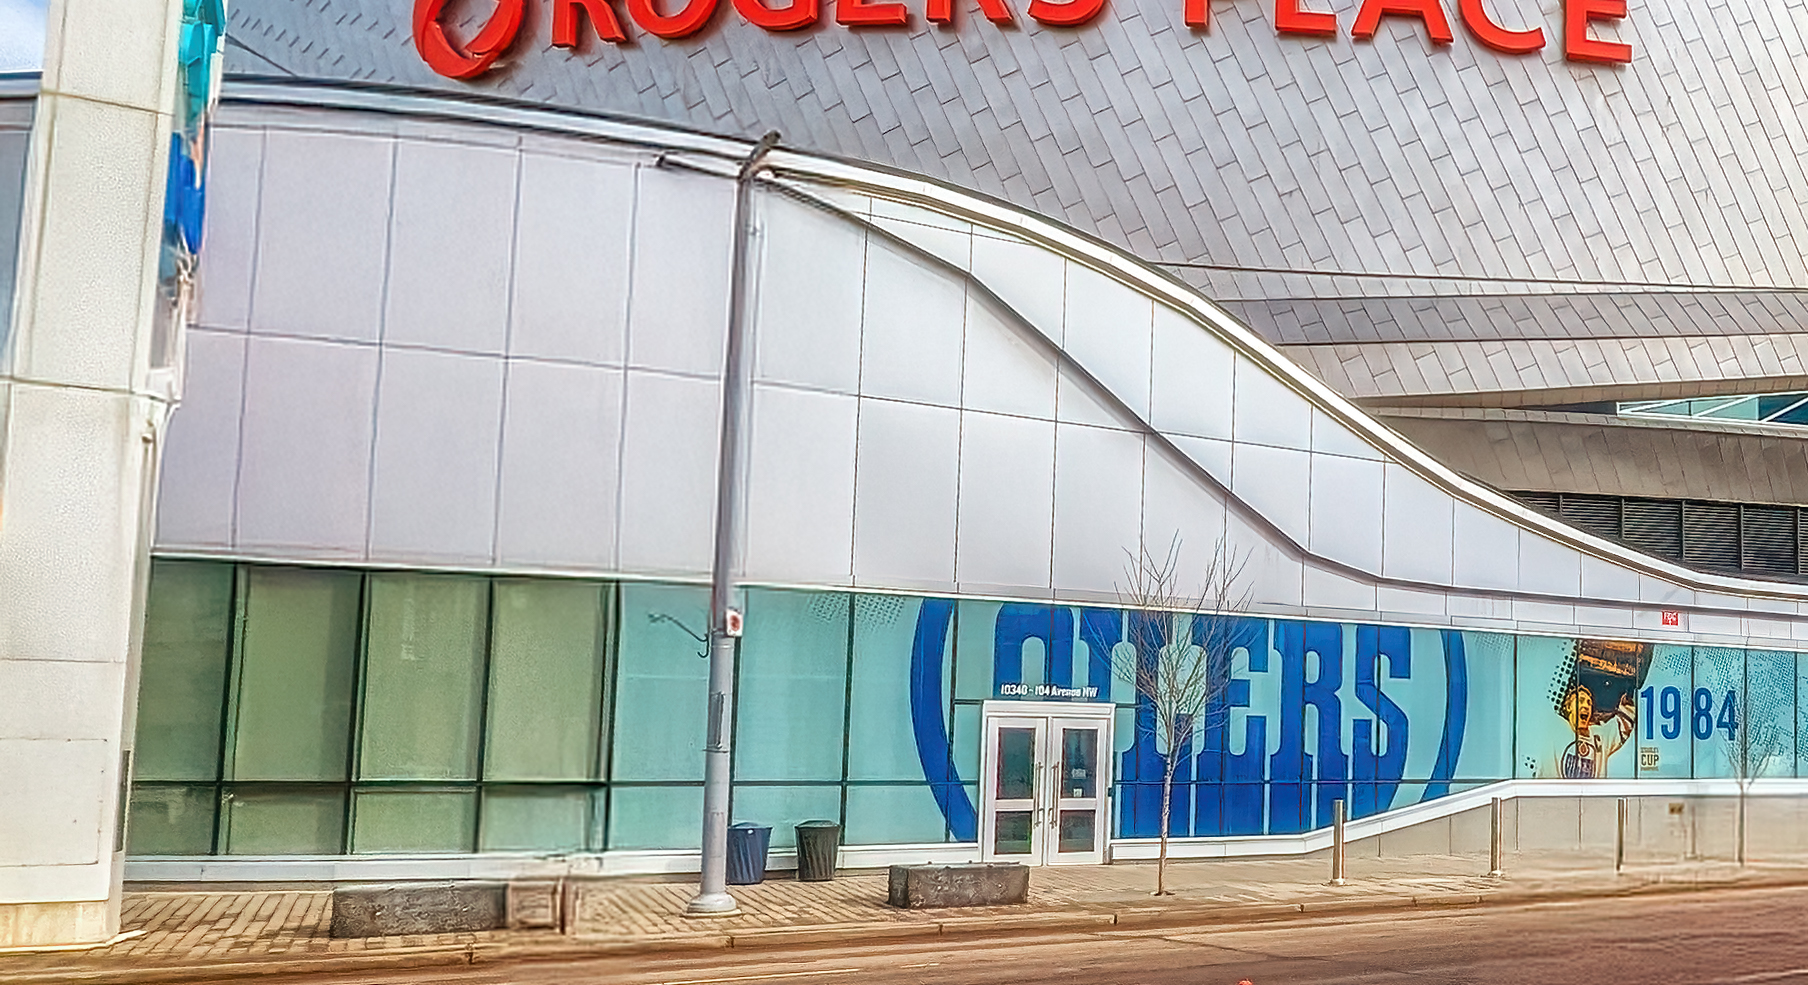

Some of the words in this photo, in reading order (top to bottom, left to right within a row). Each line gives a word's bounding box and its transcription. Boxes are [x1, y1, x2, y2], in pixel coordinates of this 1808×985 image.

[1000, 683, 1028, 696] 10340
[1034, 685, 1050, 696] 104
[1082, 686, 1099, 698] NW
[1640, 685, 1739, 741] 1984
[1641, 754, 1660, 766] CUP
